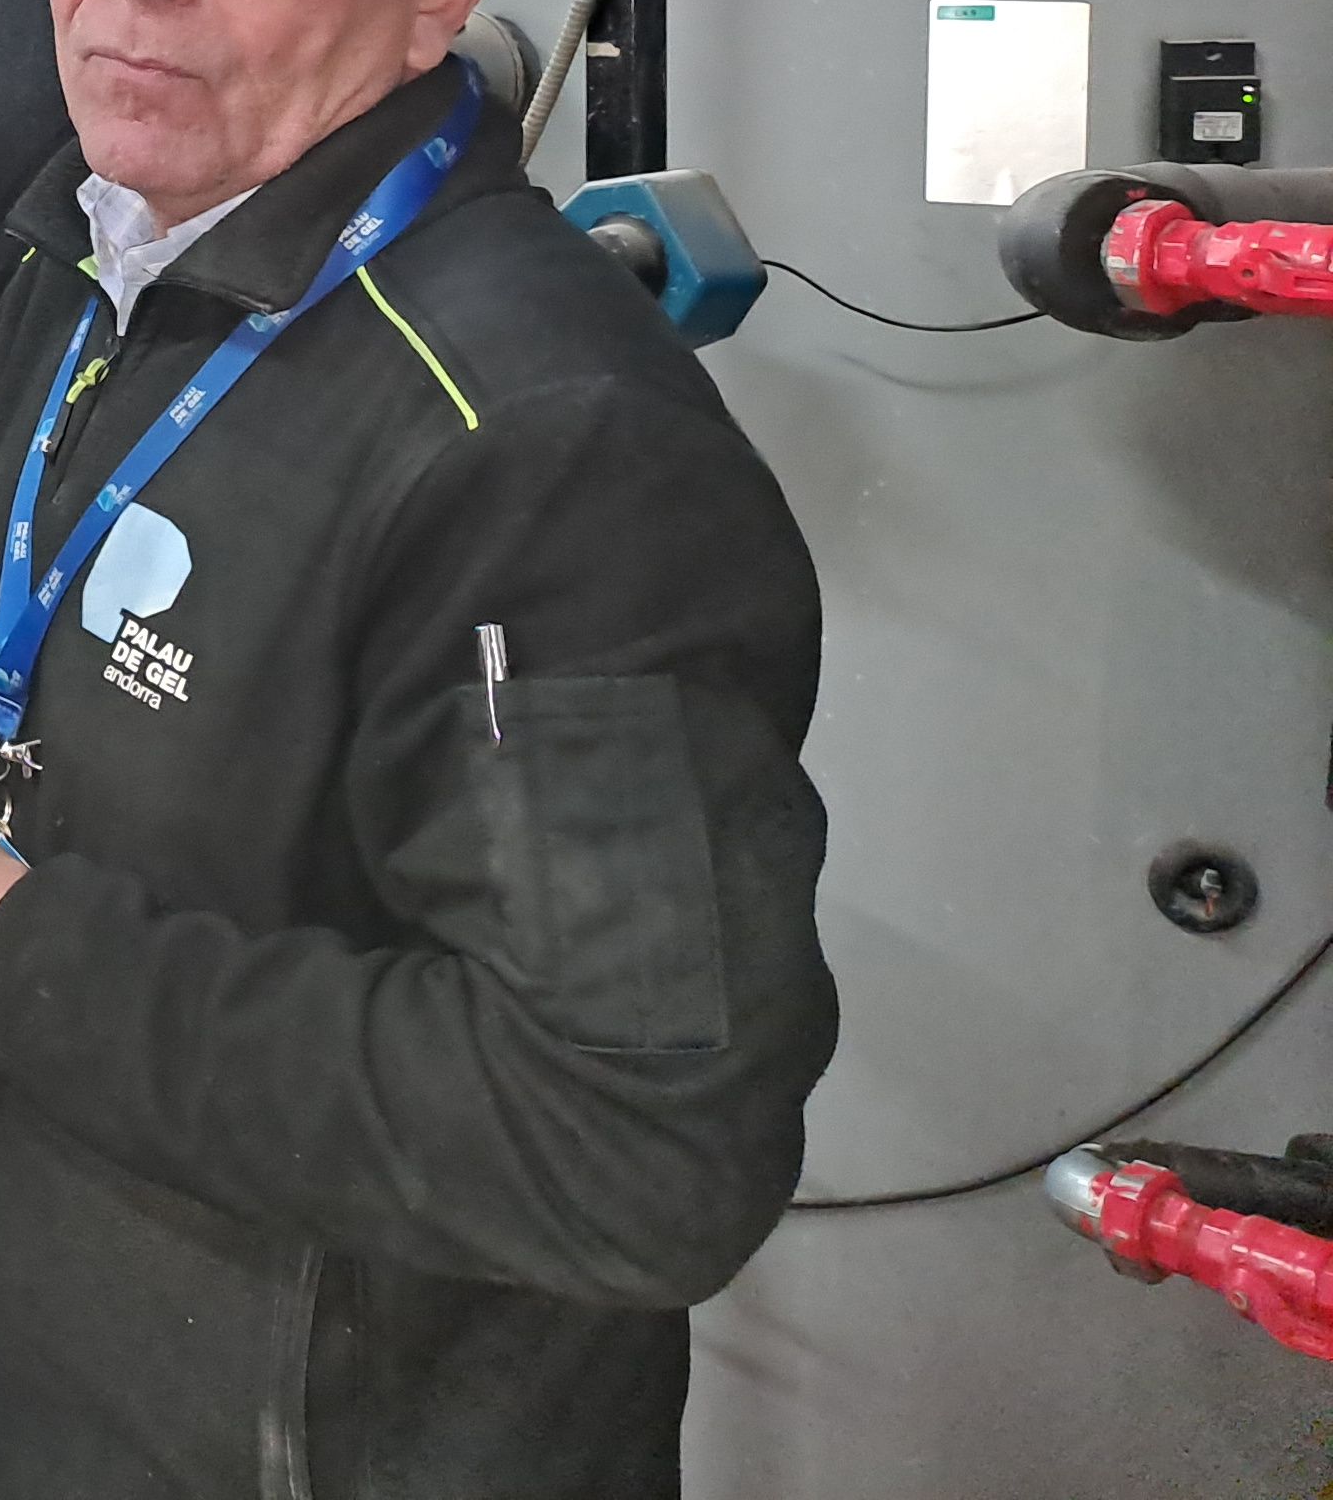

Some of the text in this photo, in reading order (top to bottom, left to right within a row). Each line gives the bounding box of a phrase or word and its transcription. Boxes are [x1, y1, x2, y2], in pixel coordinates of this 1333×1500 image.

[111, 640, 190, 702] DE GEL
[121, 619, 194, 673] PALAU
[103, 664, 162, 711] andorra
